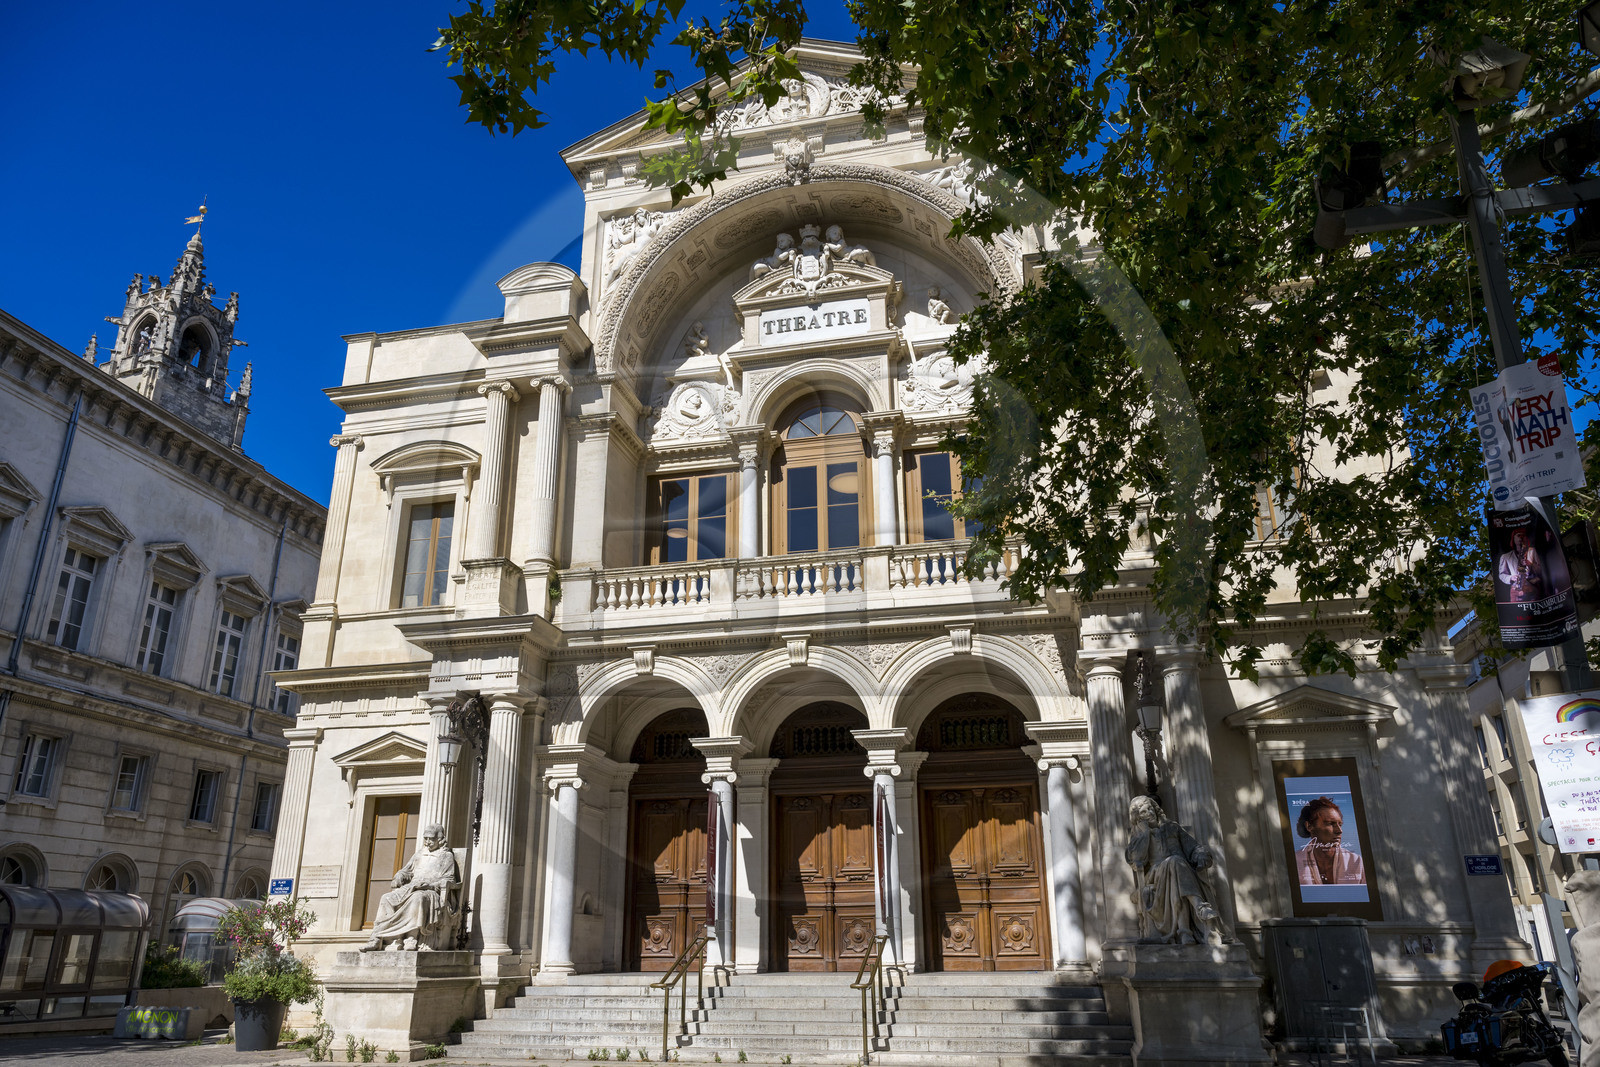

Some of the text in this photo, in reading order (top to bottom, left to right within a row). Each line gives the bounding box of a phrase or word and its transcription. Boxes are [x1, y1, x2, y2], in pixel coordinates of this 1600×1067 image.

[763, 308, 868, 335] THEATRE
[1507, 390, 1554, 422] VERY
[1513, 406, 1568, 440] MATH
[1473, 392, 1506, 483] LUCIOLES
[1516, 426, 1562, 454] TRIP
[1537, 468, 1556, 477] TRIP
[1301, 837, 1353, 852] America
[127, 1010, 179, 1024] AVIGNON
